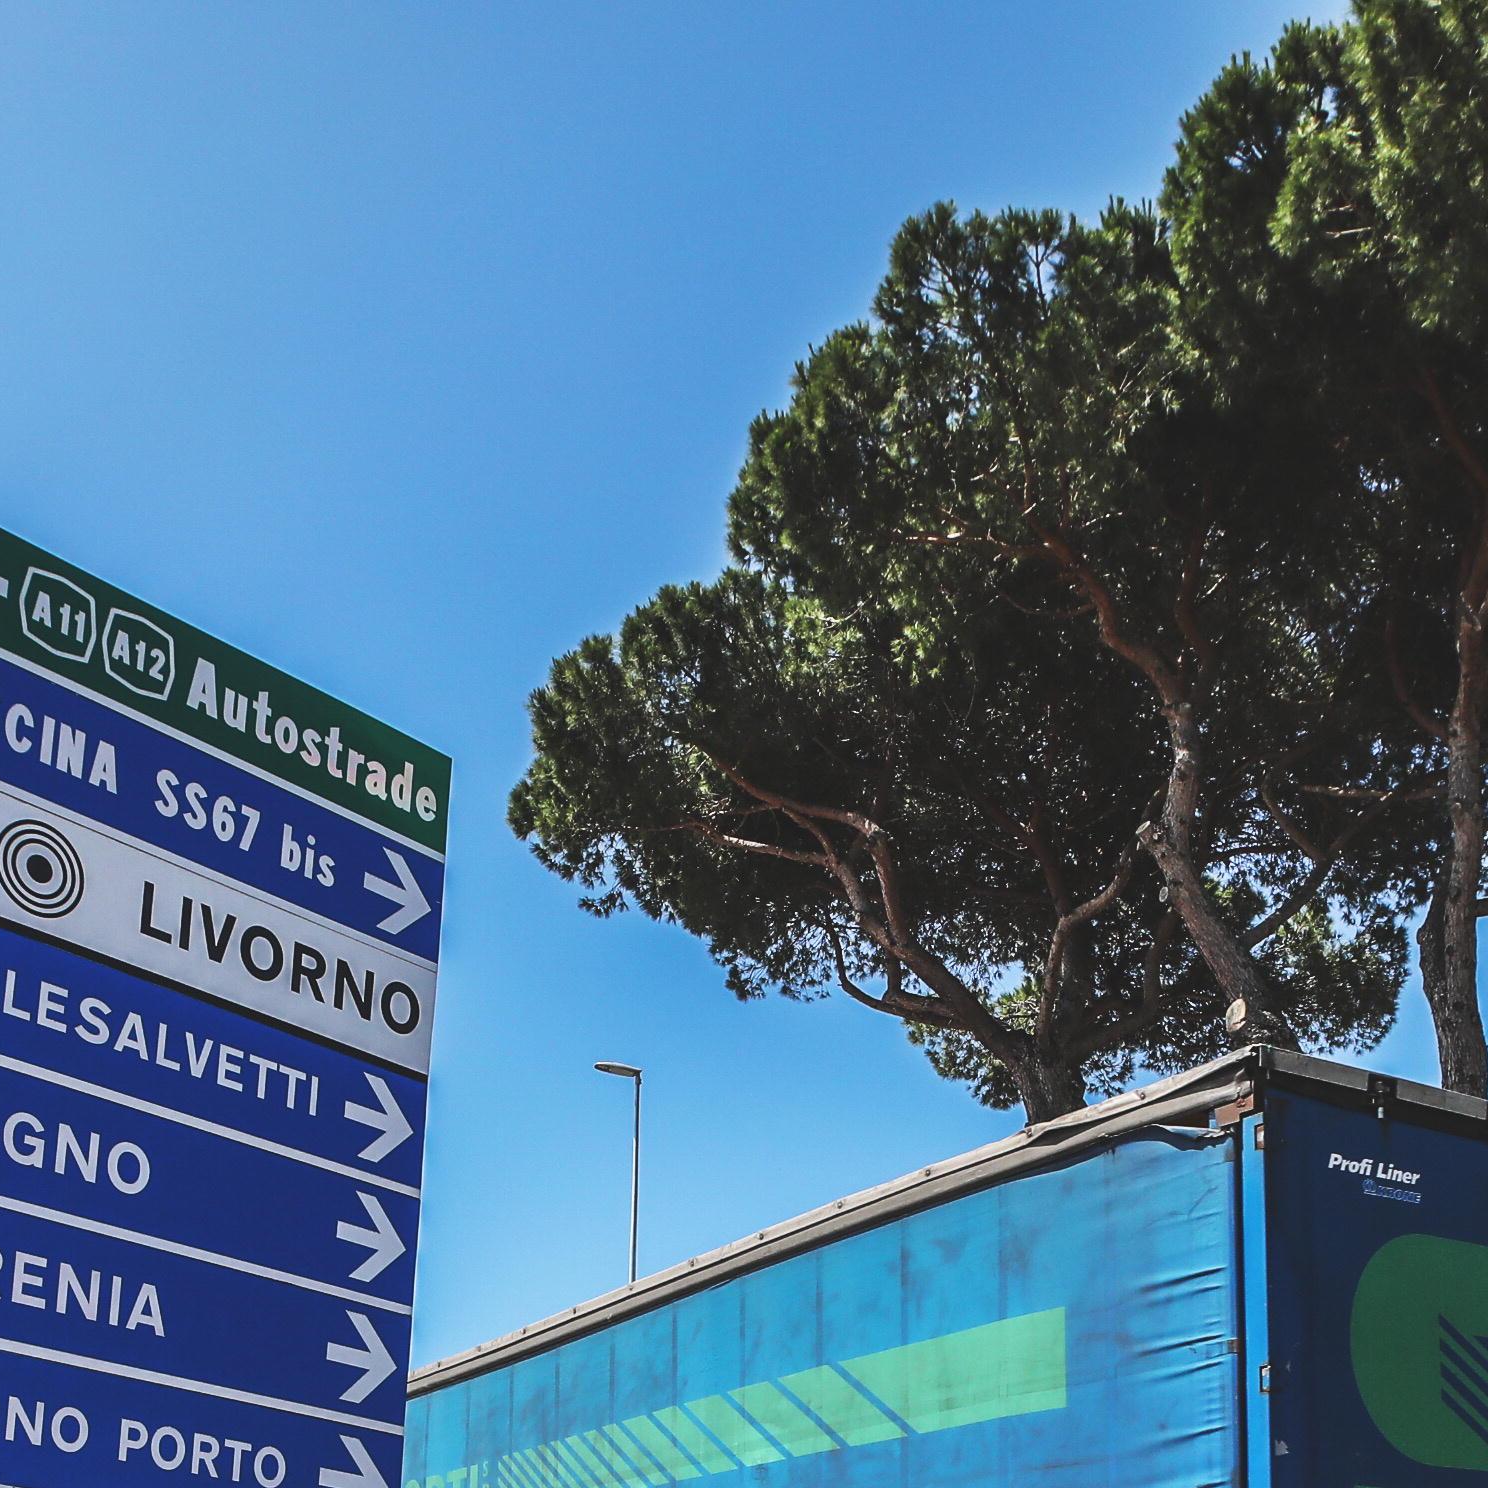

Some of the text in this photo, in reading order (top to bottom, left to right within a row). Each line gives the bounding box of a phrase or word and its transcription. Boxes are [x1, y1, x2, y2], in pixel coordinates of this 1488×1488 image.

[31, 591, 437, 822] A11 A12 Autostrade
[154, 769, 260, 851] SS67
[281, 824, 336, 888] bis
[139, 881, 421, 1036] LIVORNO
[1328, 1152, 1421, 1185] Profi Liner
[118, 1418, 286, 1488] PORTO
